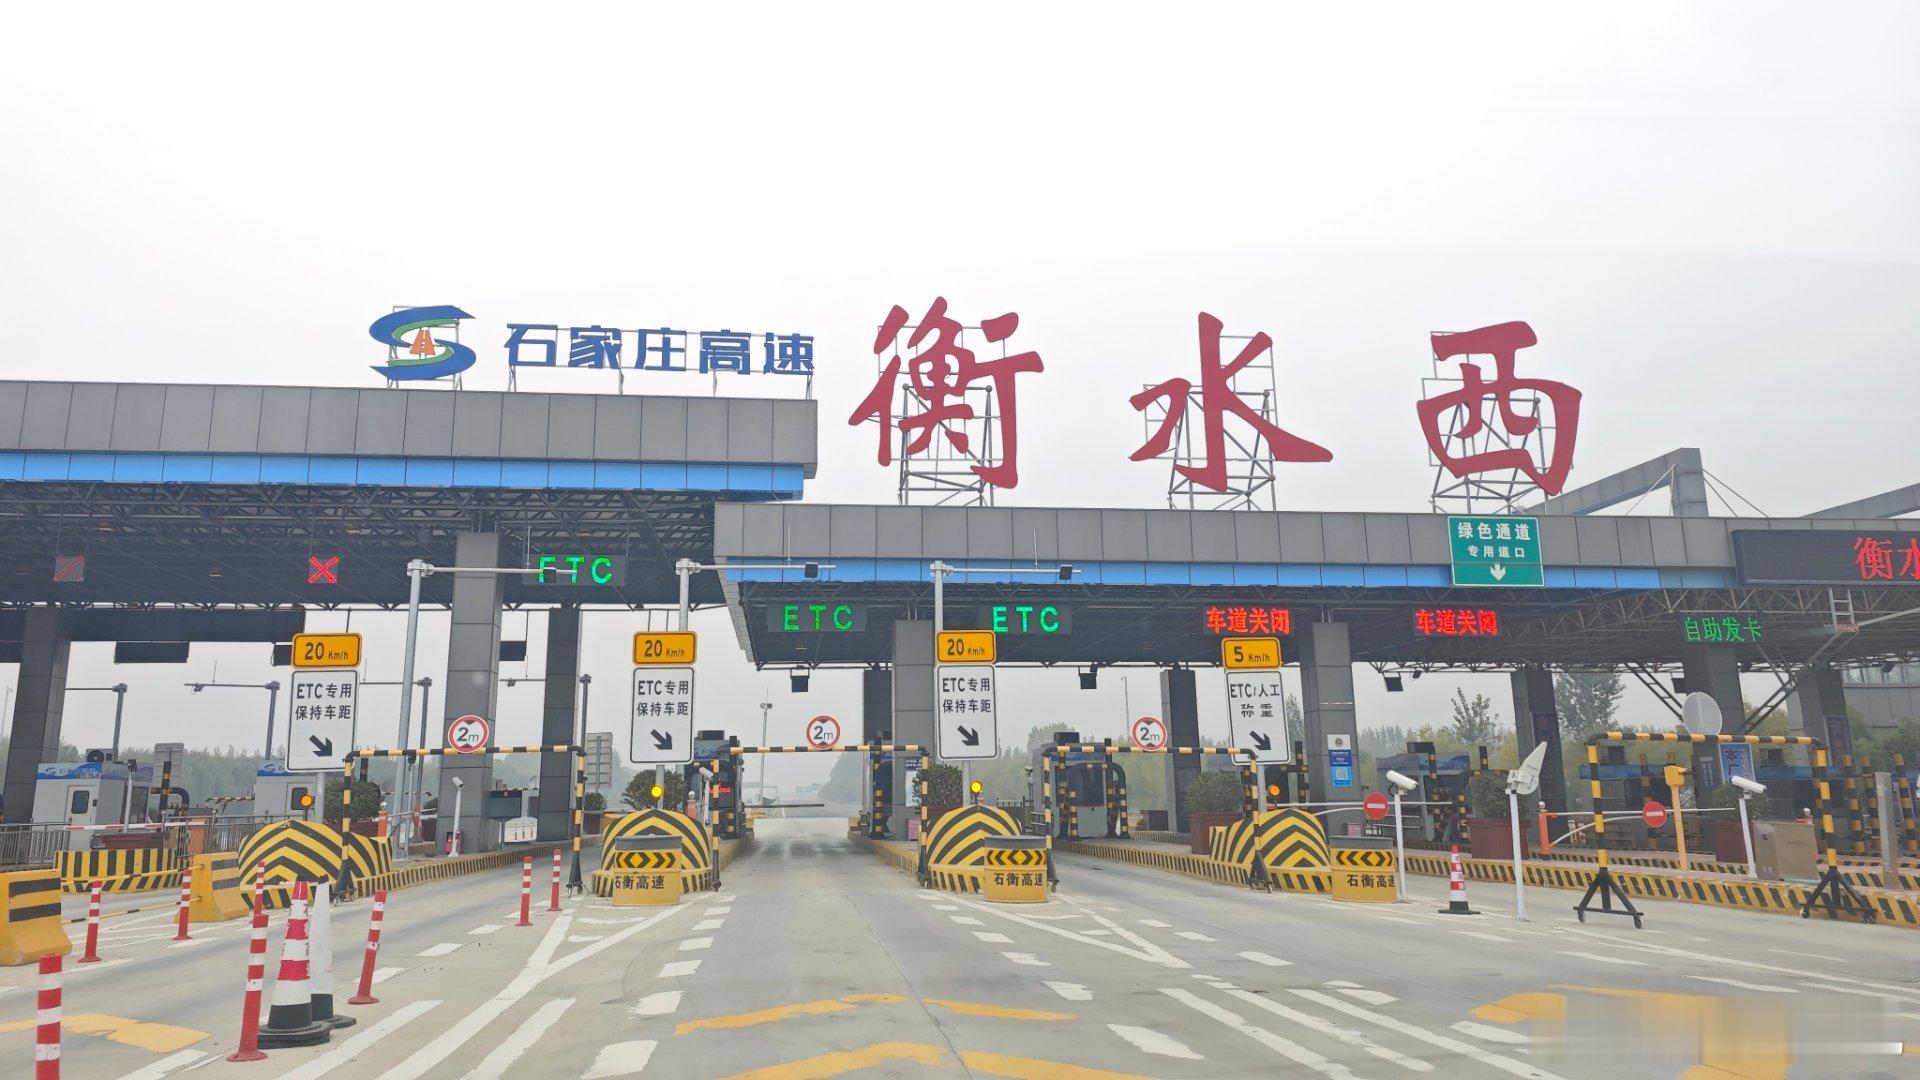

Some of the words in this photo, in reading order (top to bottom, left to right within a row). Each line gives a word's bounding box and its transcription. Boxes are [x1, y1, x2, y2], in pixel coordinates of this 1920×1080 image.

[504, 324, 815, 375] 石家庄高速
[848, 296, 1582, 497] 衡水西
[1457, 522, 1531, 541] 绿色通道
[1467, 545, 1525, 558] 专用道口
[784, 604, 853, 631] ETC
[992, 606, 1059, 633] ETC
[1206, 606, 1291, 634] 车道关闭
[1415, 609, 1498, 636] 车道关闭
[1684, 617, 1762, 642] 自助发卡
[304, 642, 325, 660] 20
[328, 651, 349, 660] Km/h
[644, 640, 663, 657] 20
[665, 648, 685, 658] Km/h
[947, 638, 965, 656] 20
[967, 647, 985, 656] Km/h
[1233, 646, 1244, 663] 5
[1248, 653, 1271, 663] Km/h
[1230, 683, 1281, 699] ETC/人工
[295, 705, 352, 721] 保持车距
[637, 702, 689, 717] 保持车距
[942, 699, 992, 714] 保持车距
[1241, 703, 1274, 718] 称重
[457, 727, 479, 743] 2m
[813, 725, 834, 741] 2m
[1140, 727, 1160, 742] 2m
[994, 872, 1044, 887] 石衡高速
